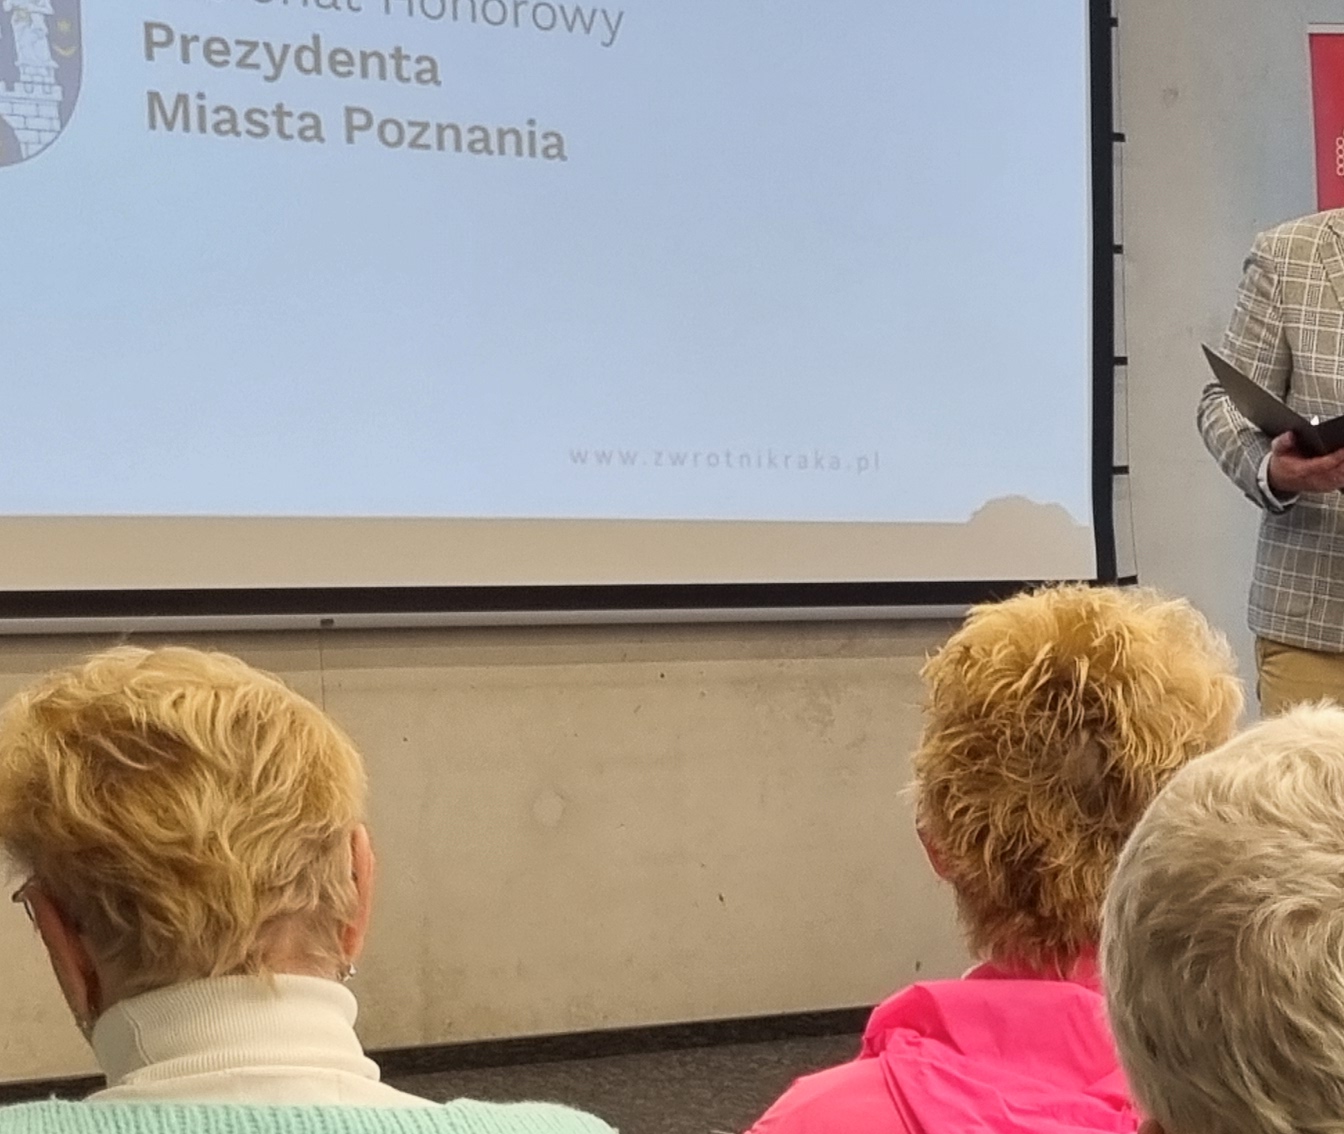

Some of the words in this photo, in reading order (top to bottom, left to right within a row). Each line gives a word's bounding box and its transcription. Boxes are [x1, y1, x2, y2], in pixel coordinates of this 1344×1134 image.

[142, 21, 442, 87] Prezydenta
[146, 90, 325, 145] Miasta
[343, 106, 569, 163] Poznania
[568, 449, 881, 475] www.zwrotnikraka.pl
